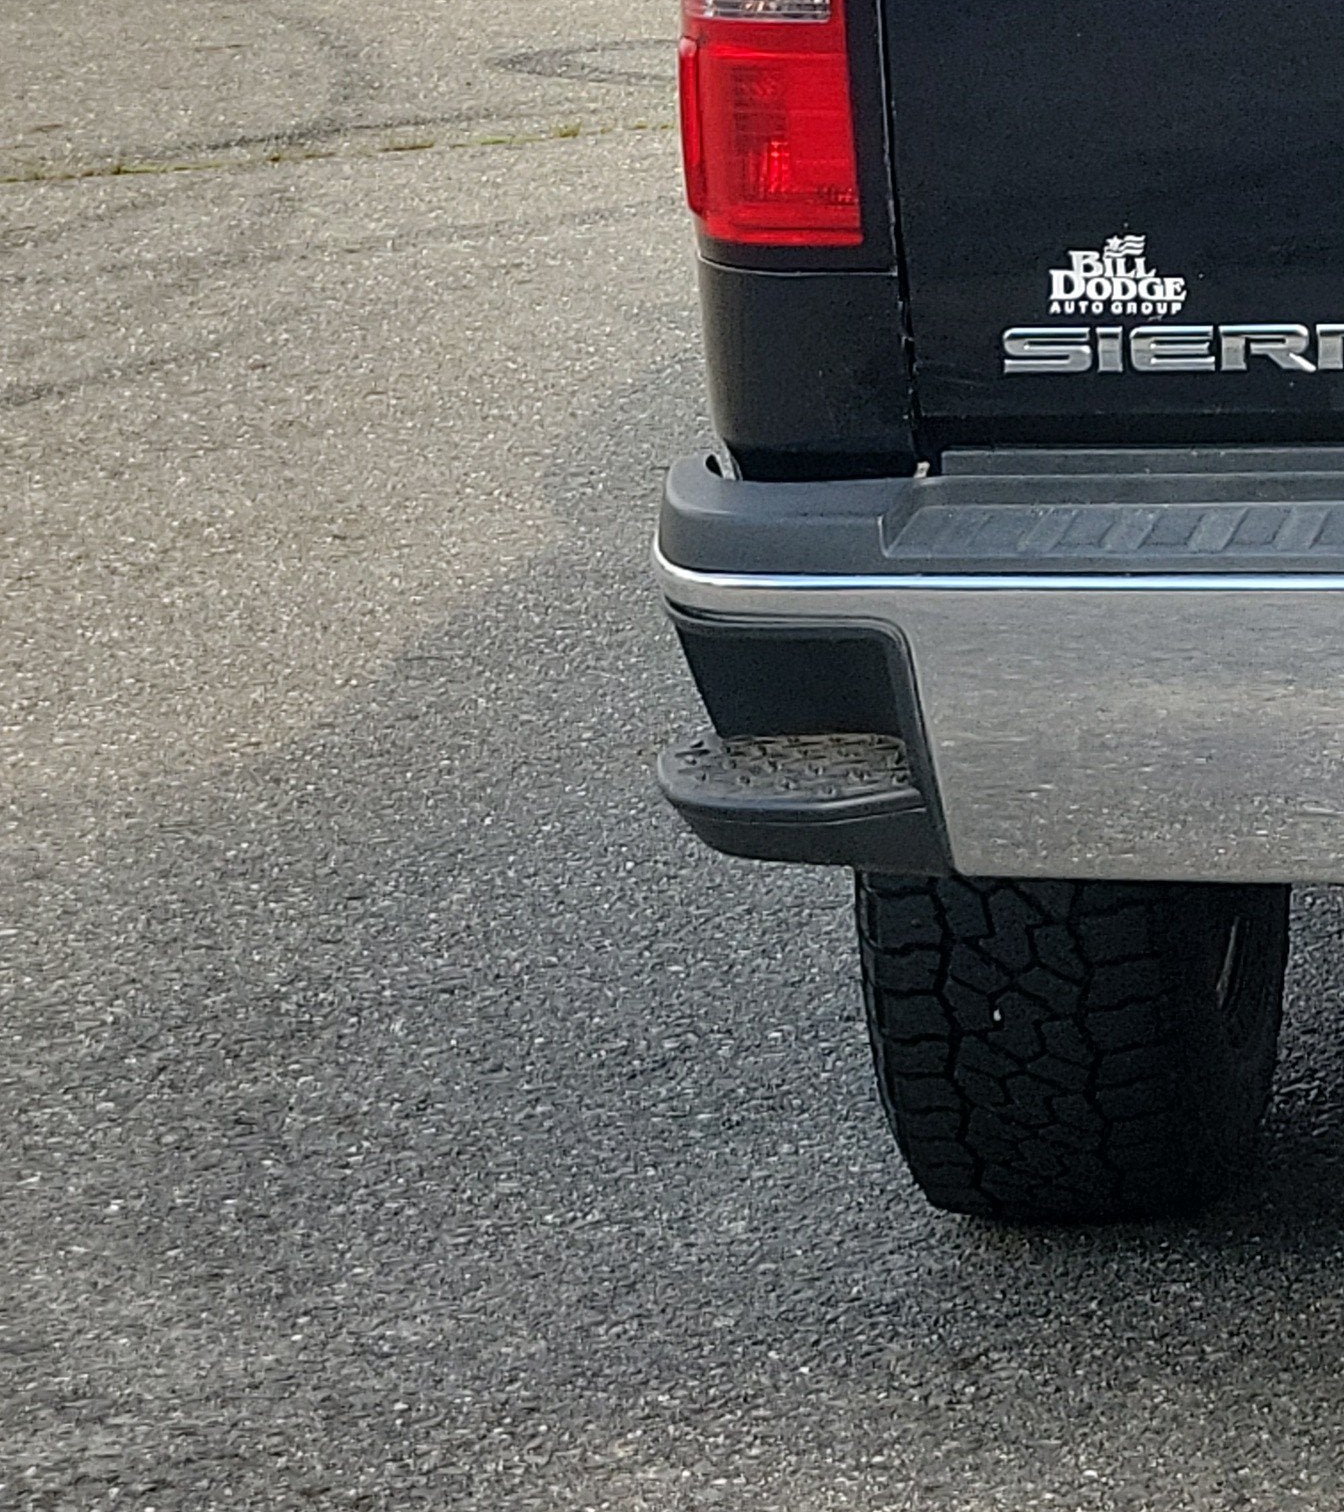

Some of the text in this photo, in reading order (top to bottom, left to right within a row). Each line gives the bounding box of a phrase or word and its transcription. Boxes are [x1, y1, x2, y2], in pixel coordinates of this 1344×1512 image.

[1067, 250, 1157, 278] BILL
[1049, 269, 1188, 301] DODGE
[1049, 301, 1183, 315] AUTO GROUP
